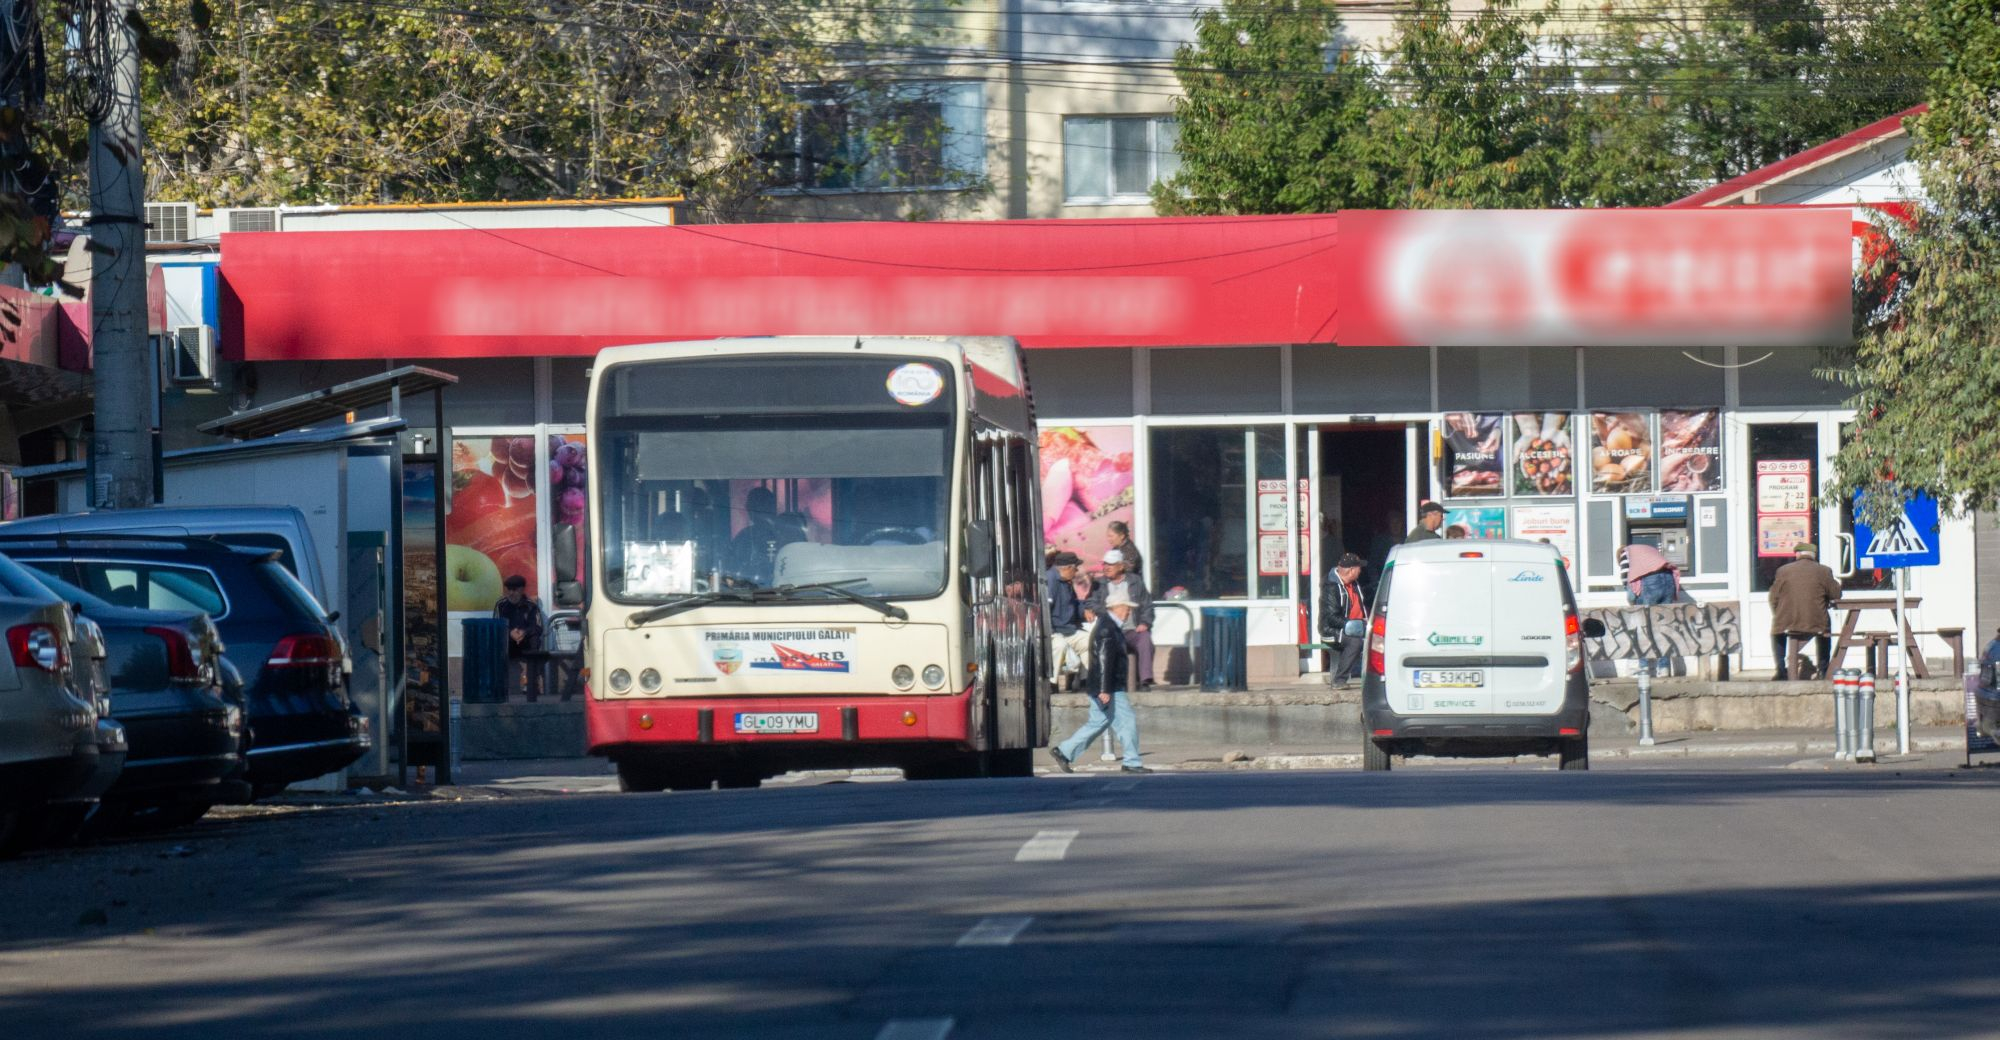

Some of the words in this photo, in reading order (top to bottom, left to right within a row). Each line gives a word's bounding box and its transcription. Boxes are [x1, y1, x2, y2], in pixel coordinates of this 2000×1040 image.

[1455, 452, 1495, 460] PASIUNE
[1509, 570, 1544, 582] Linde
[752, 630, 816, 641] MUNICIPIULUI
[1420, 673, 1436, 683] GL
[1434, 700, 1476, 708] SERVICE
[743, 715, 761, 728] GL
[767, 715, 783, 728] 09
[785, 715, 815, 728] YMU
